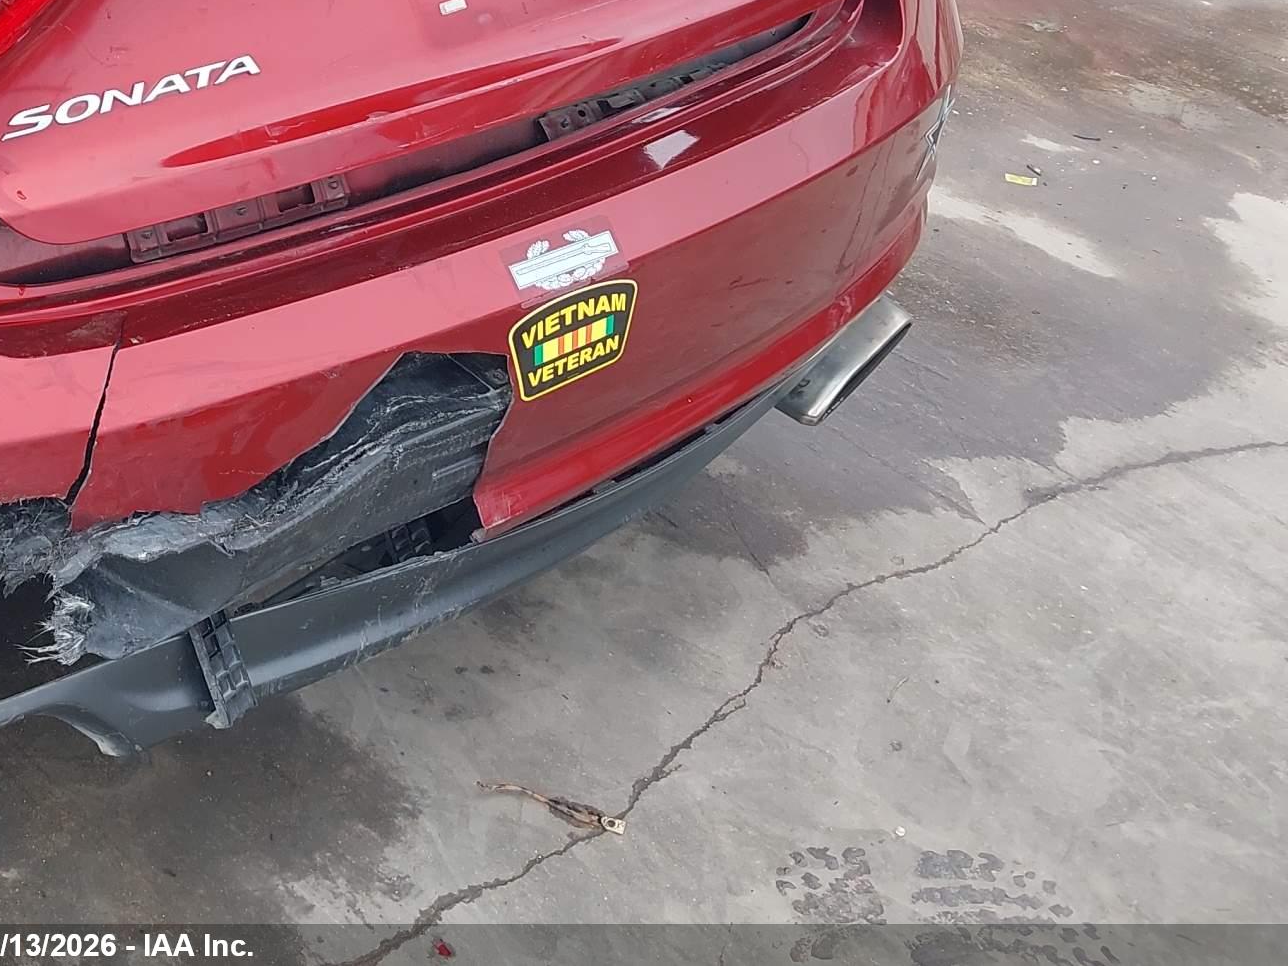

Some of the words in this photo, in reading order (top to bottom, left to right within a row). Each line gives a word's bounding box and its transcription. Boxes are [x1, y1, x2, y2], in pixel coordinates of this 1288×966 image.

[0, 54, 261, 141] SONATA
[521, 293, 627, 349] VIETNAM
[527, 334, 619, 387] VETERAN
